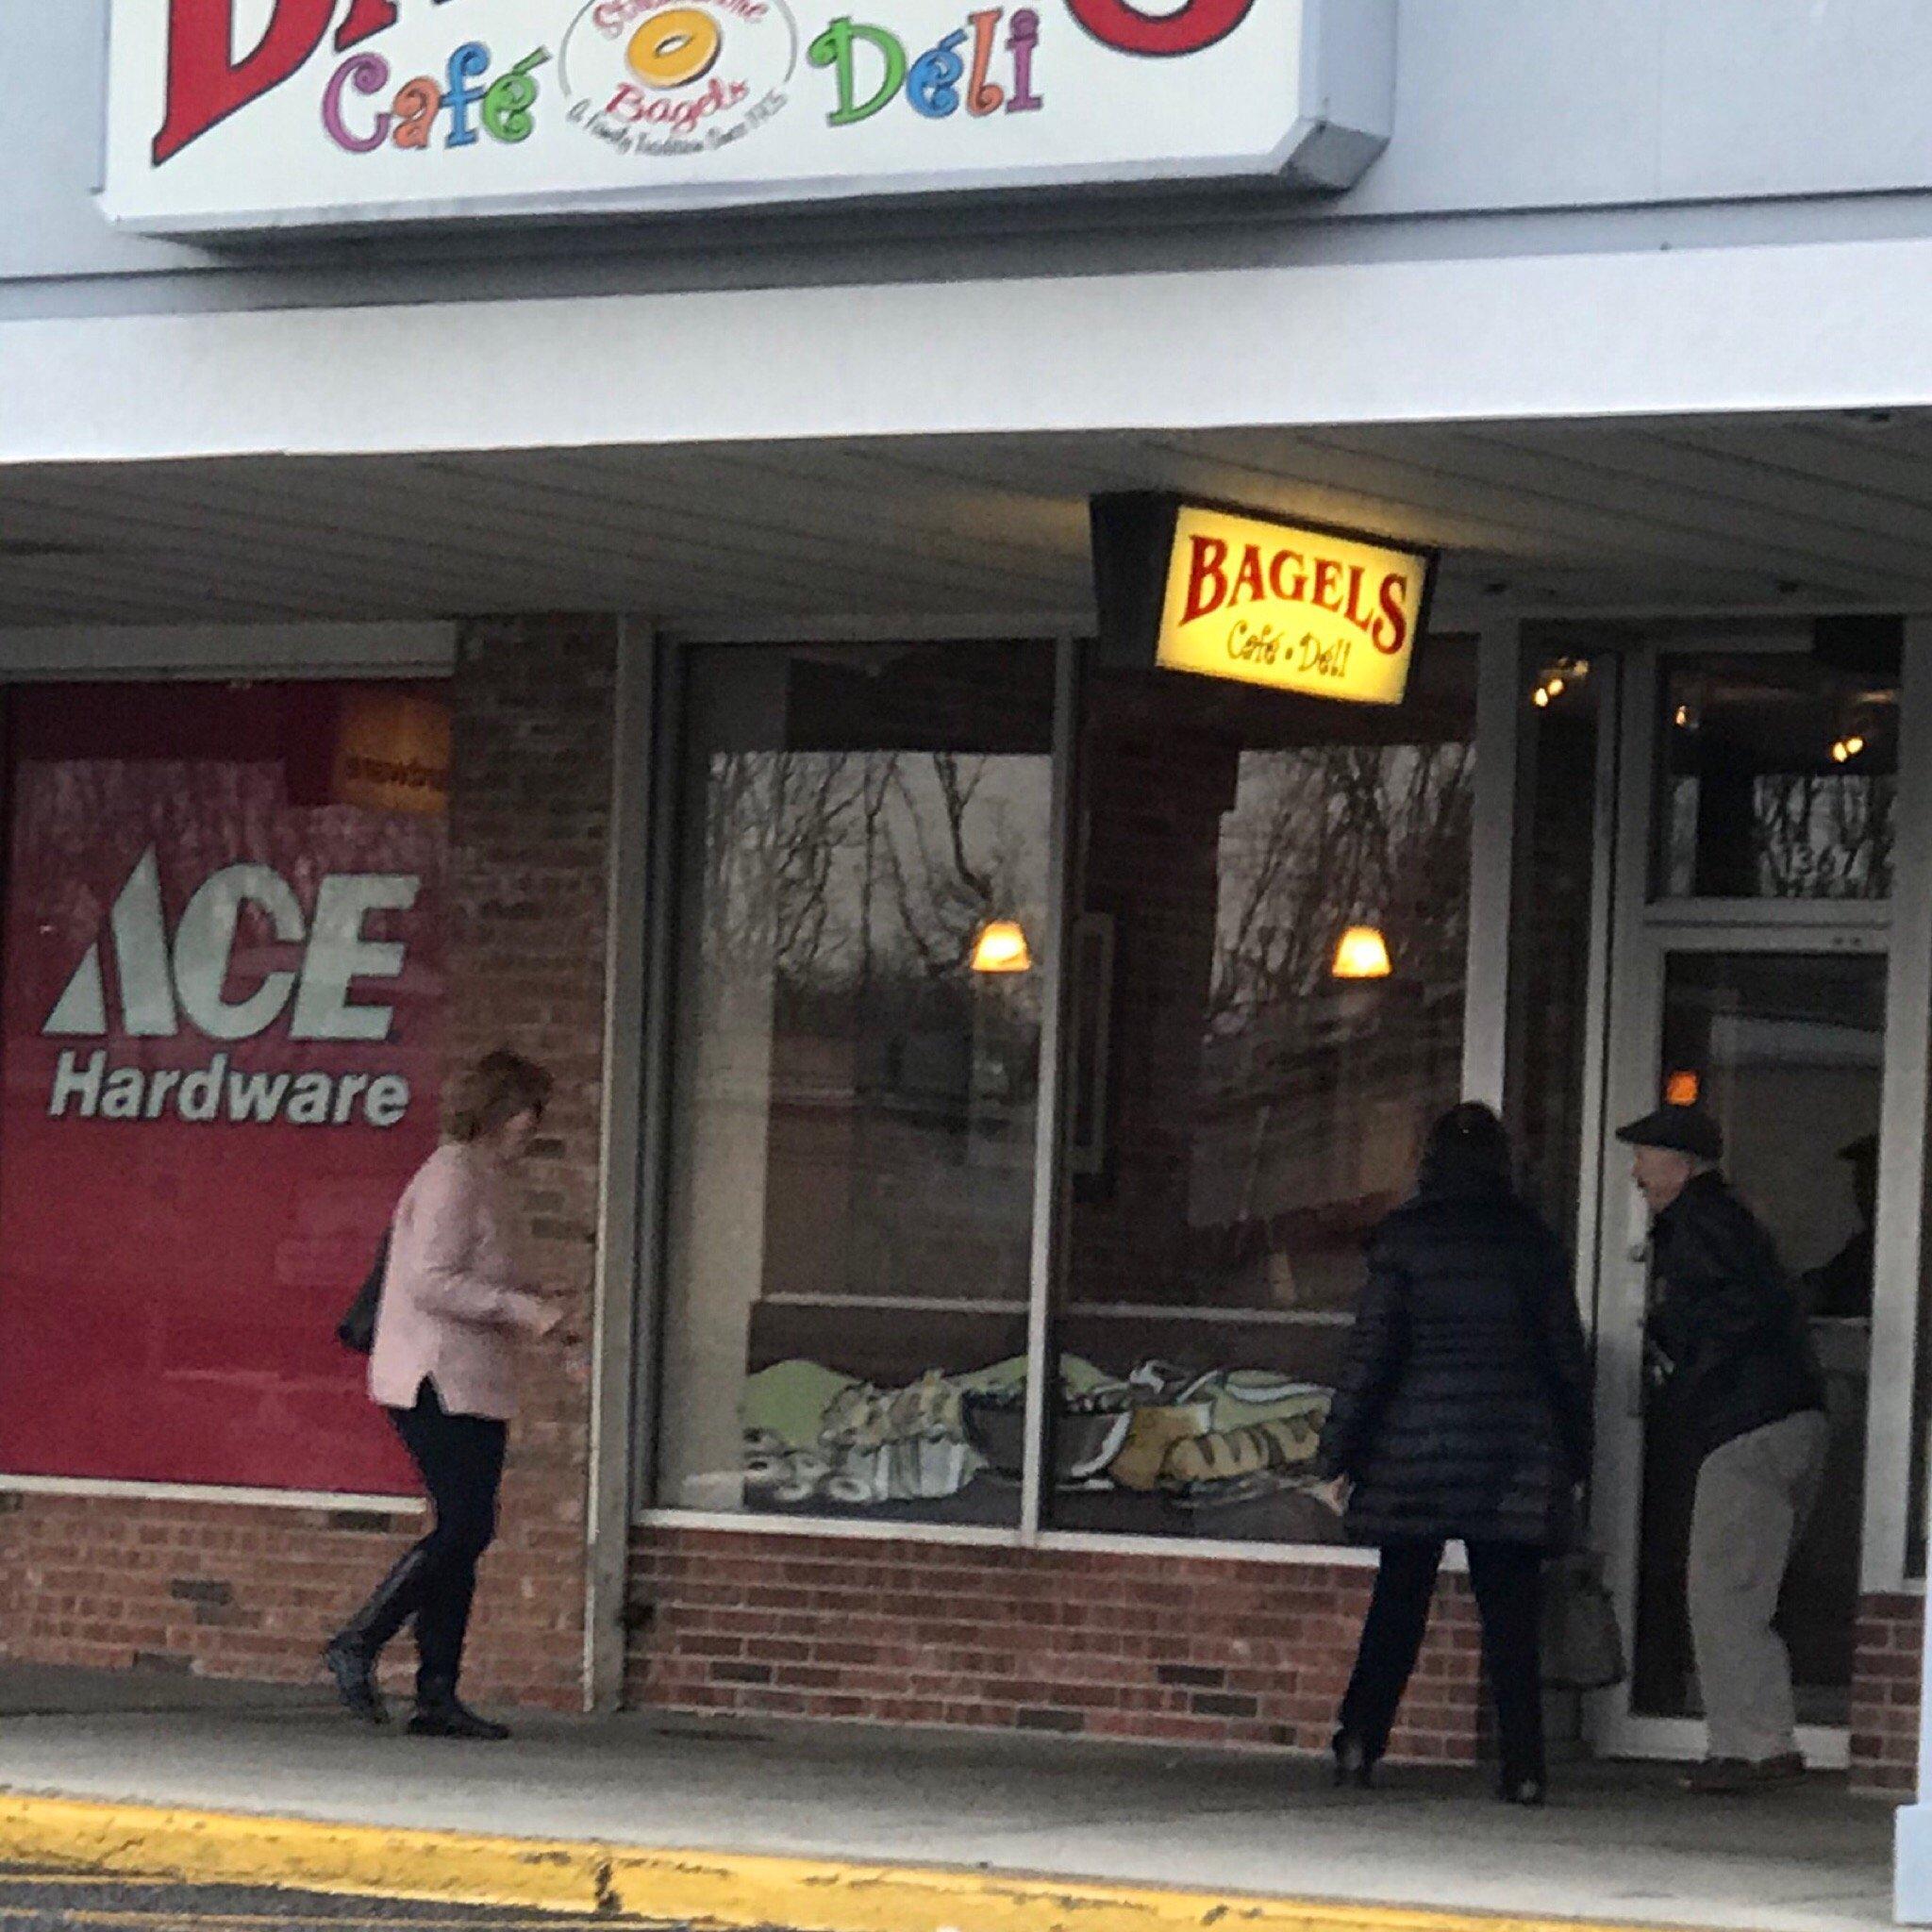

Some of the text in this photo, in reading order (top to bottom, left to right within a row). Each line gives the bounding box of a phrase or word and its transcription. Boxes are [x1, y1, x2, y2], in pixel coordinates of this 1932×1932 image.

[322, 41, 553, 154] Café
[1178, 534, 1407, 655] BAGELS
[42, 841, 422, 1041] ACE
[49, 1048, 410, 1127] Hardware
